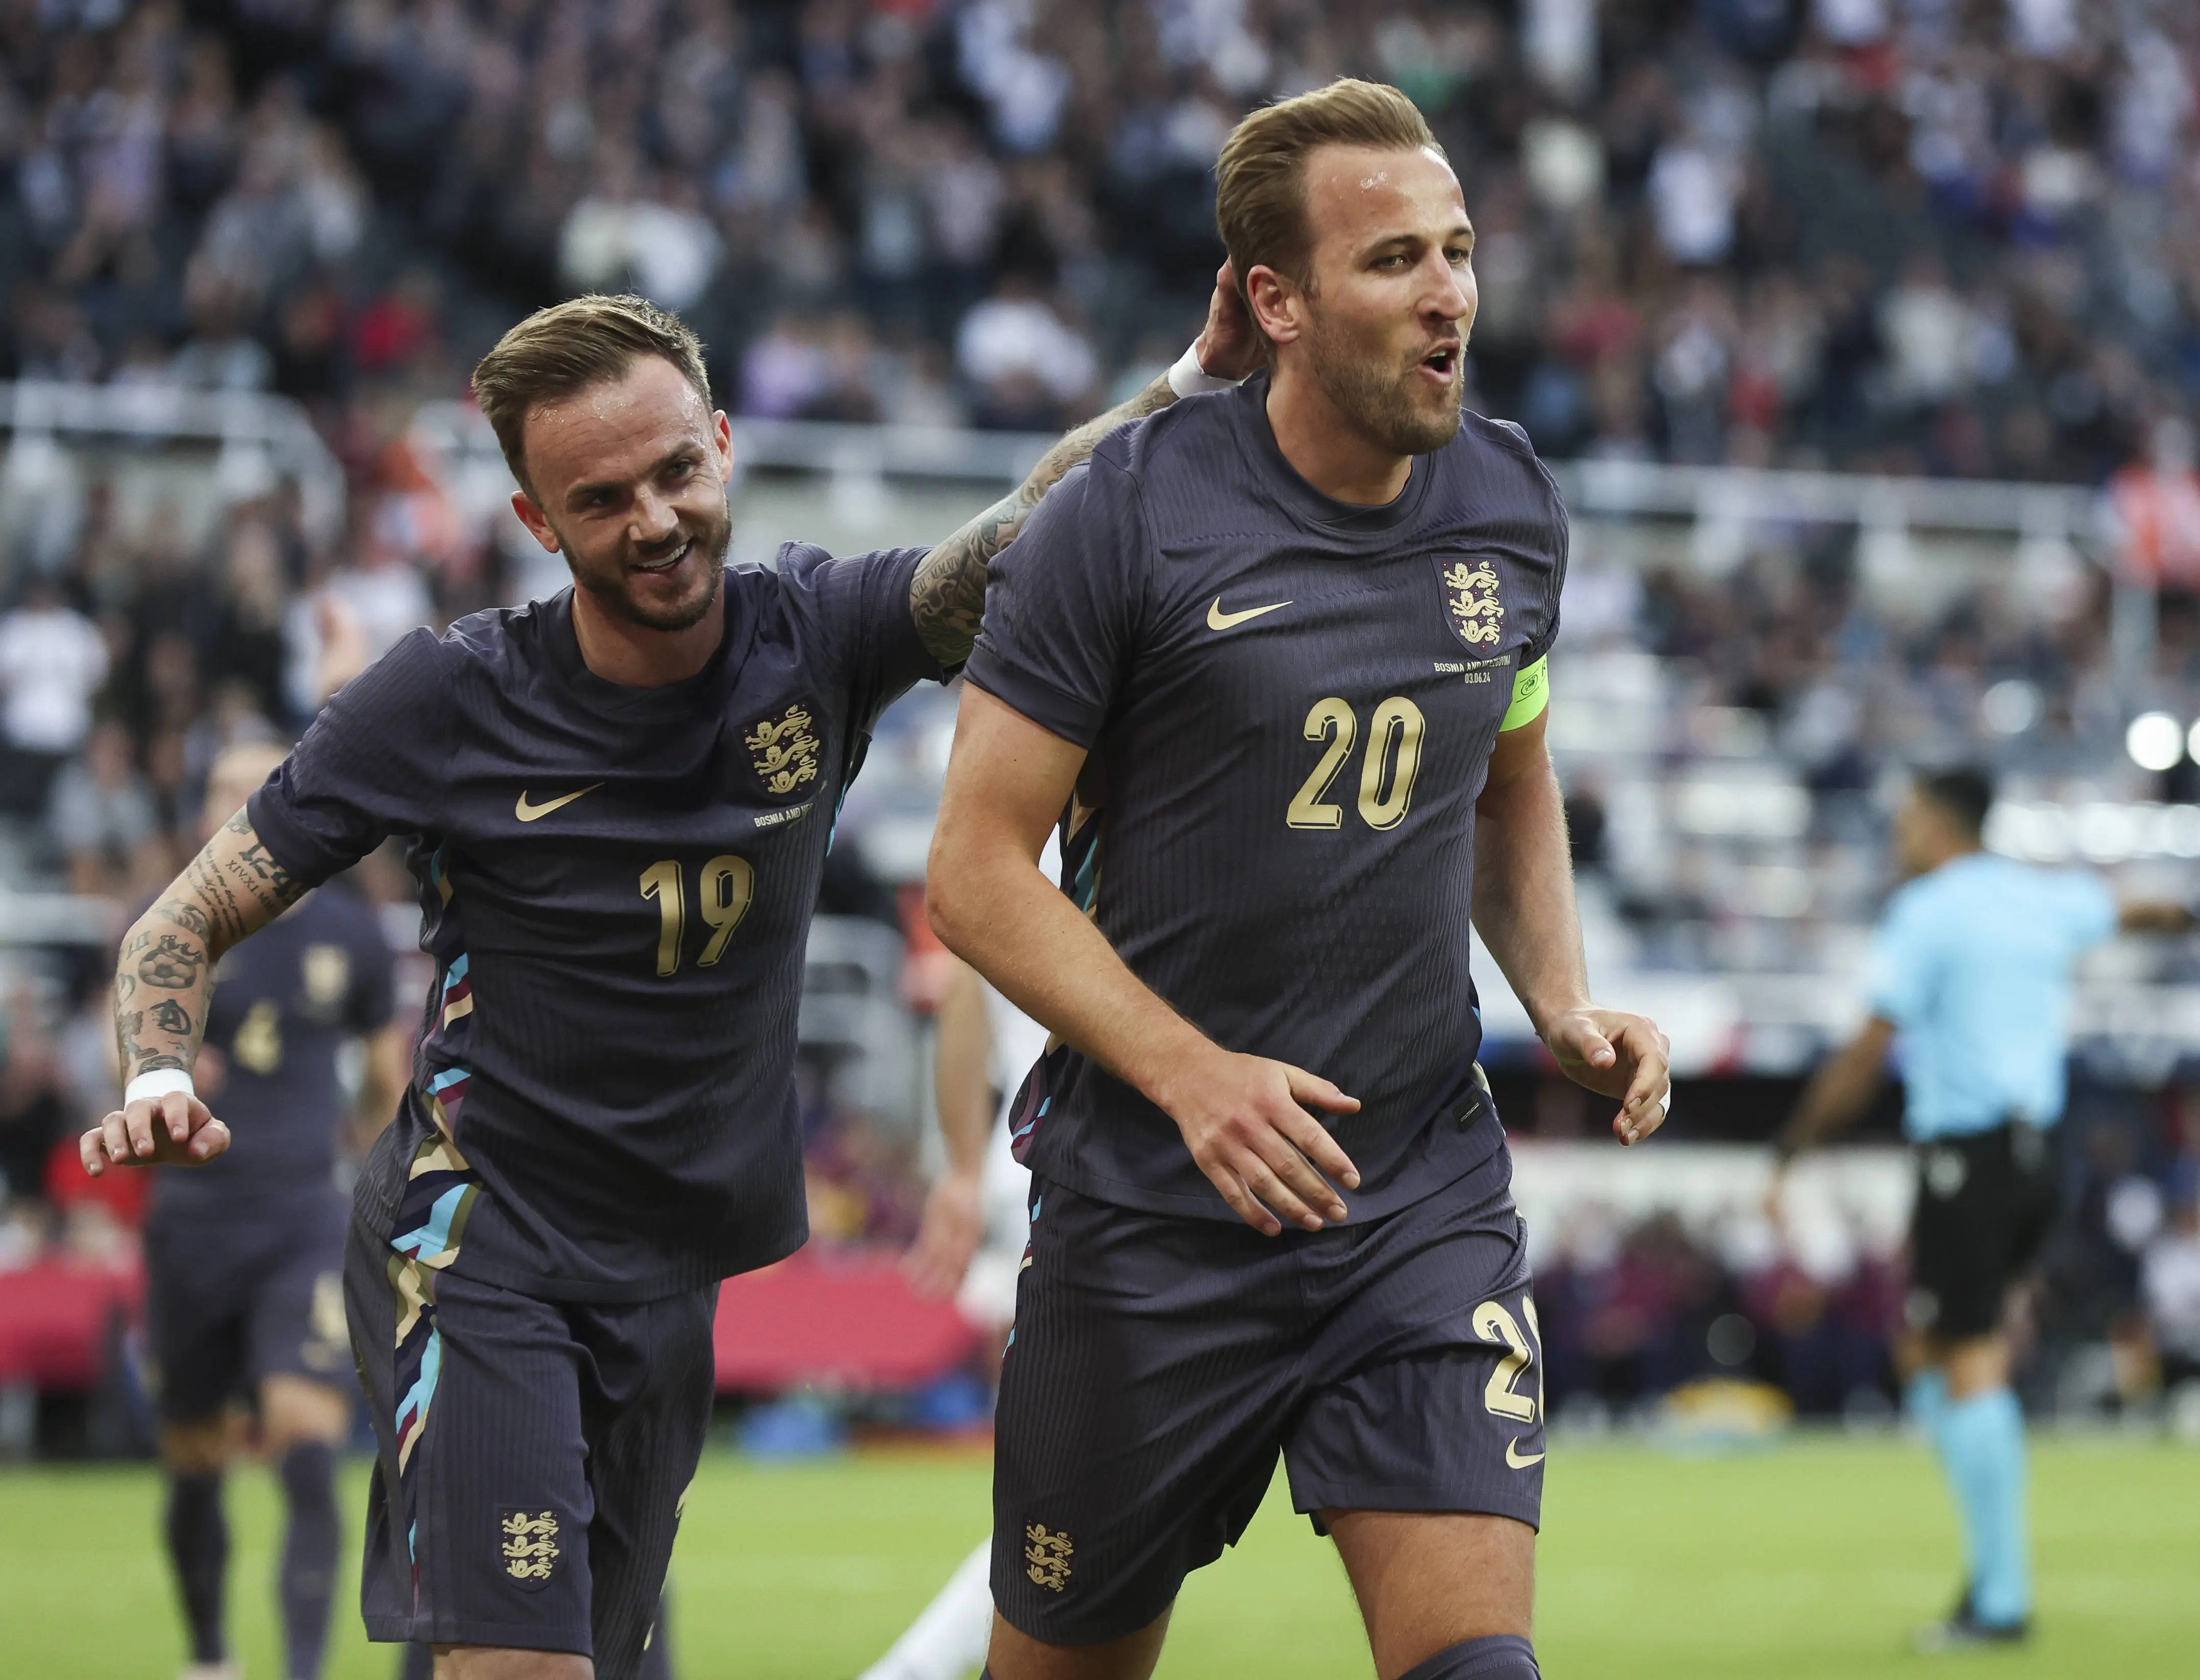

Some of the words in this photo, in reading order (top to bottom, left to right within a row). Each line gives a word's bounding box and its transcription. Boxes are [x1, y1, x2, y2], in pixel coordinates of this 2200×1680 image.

[1433, 662, 1464, 672] BOSNIA
[1466, 661, 1481, 672] AND
[1464, 672, 1490, 684] 03.06.24
[1286, 696, 1426, 831] 20
[753, 812, 785, 827] BOSNIA
[786, 807, 801, 821] AND
[640, 854, 754, 977] 19
